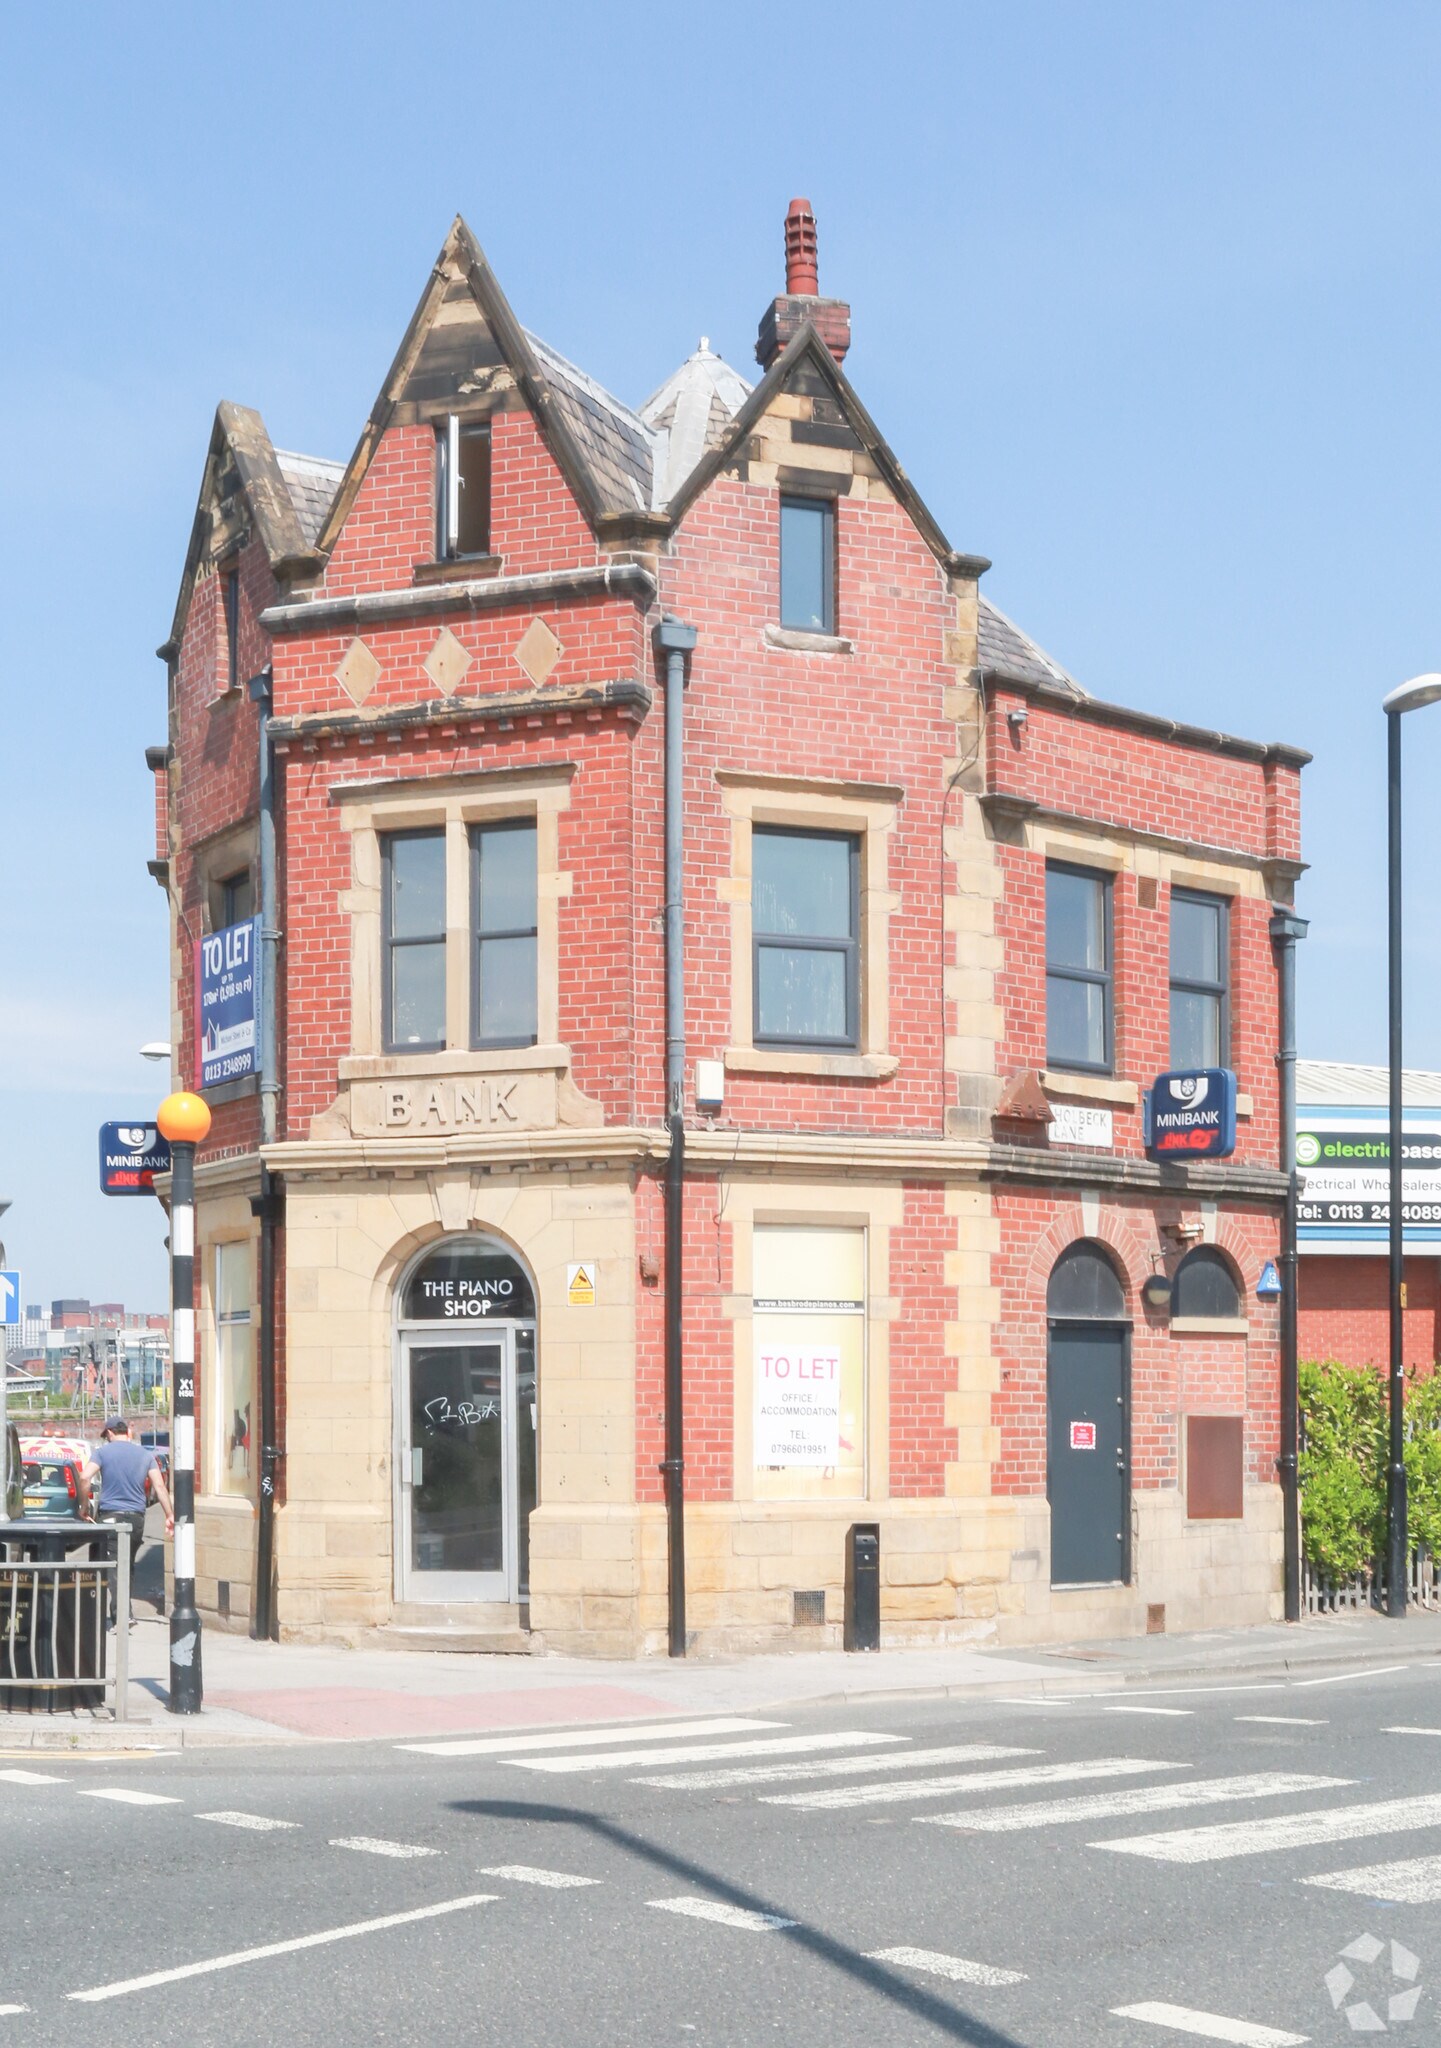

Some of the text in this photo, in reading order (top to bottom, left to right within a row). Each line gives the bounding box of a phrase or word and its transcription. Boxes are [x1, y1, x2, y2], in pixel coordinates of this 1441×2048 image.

[203, 923, 253, 978] TO LET
[221, 975, 228, 984] UP
[236, 982, 243, 994] SQ
[205, 1062, 221, 1081] 0113
[386, 1082, 518, 1128] BANK
[1055, 1107, 1107, 1128] HOLBECK
[1157, 1110, 1219, 1128] MINIBANK
[1054, 1124, 1084, 1141] LANE
[106, 1155, 169, 1167] MINIBANK
[1296, 1204, 1322, 1219] Tel:
[1329, 1204, 1364, 1219] 0113
[423, 1279, 513, 1297] THE PIANO
[444, 1300, 492, 1316] SHOP
[761, 1357, 838, 1379] TO LET
[782, 1393, 813, 1403] OFFICE
[761, 1406, 838, 1416] ACCOMMODATION
[790, 1430, 810, 1440] TEL:
[771, 1444, 827, 1454] 07966019951
